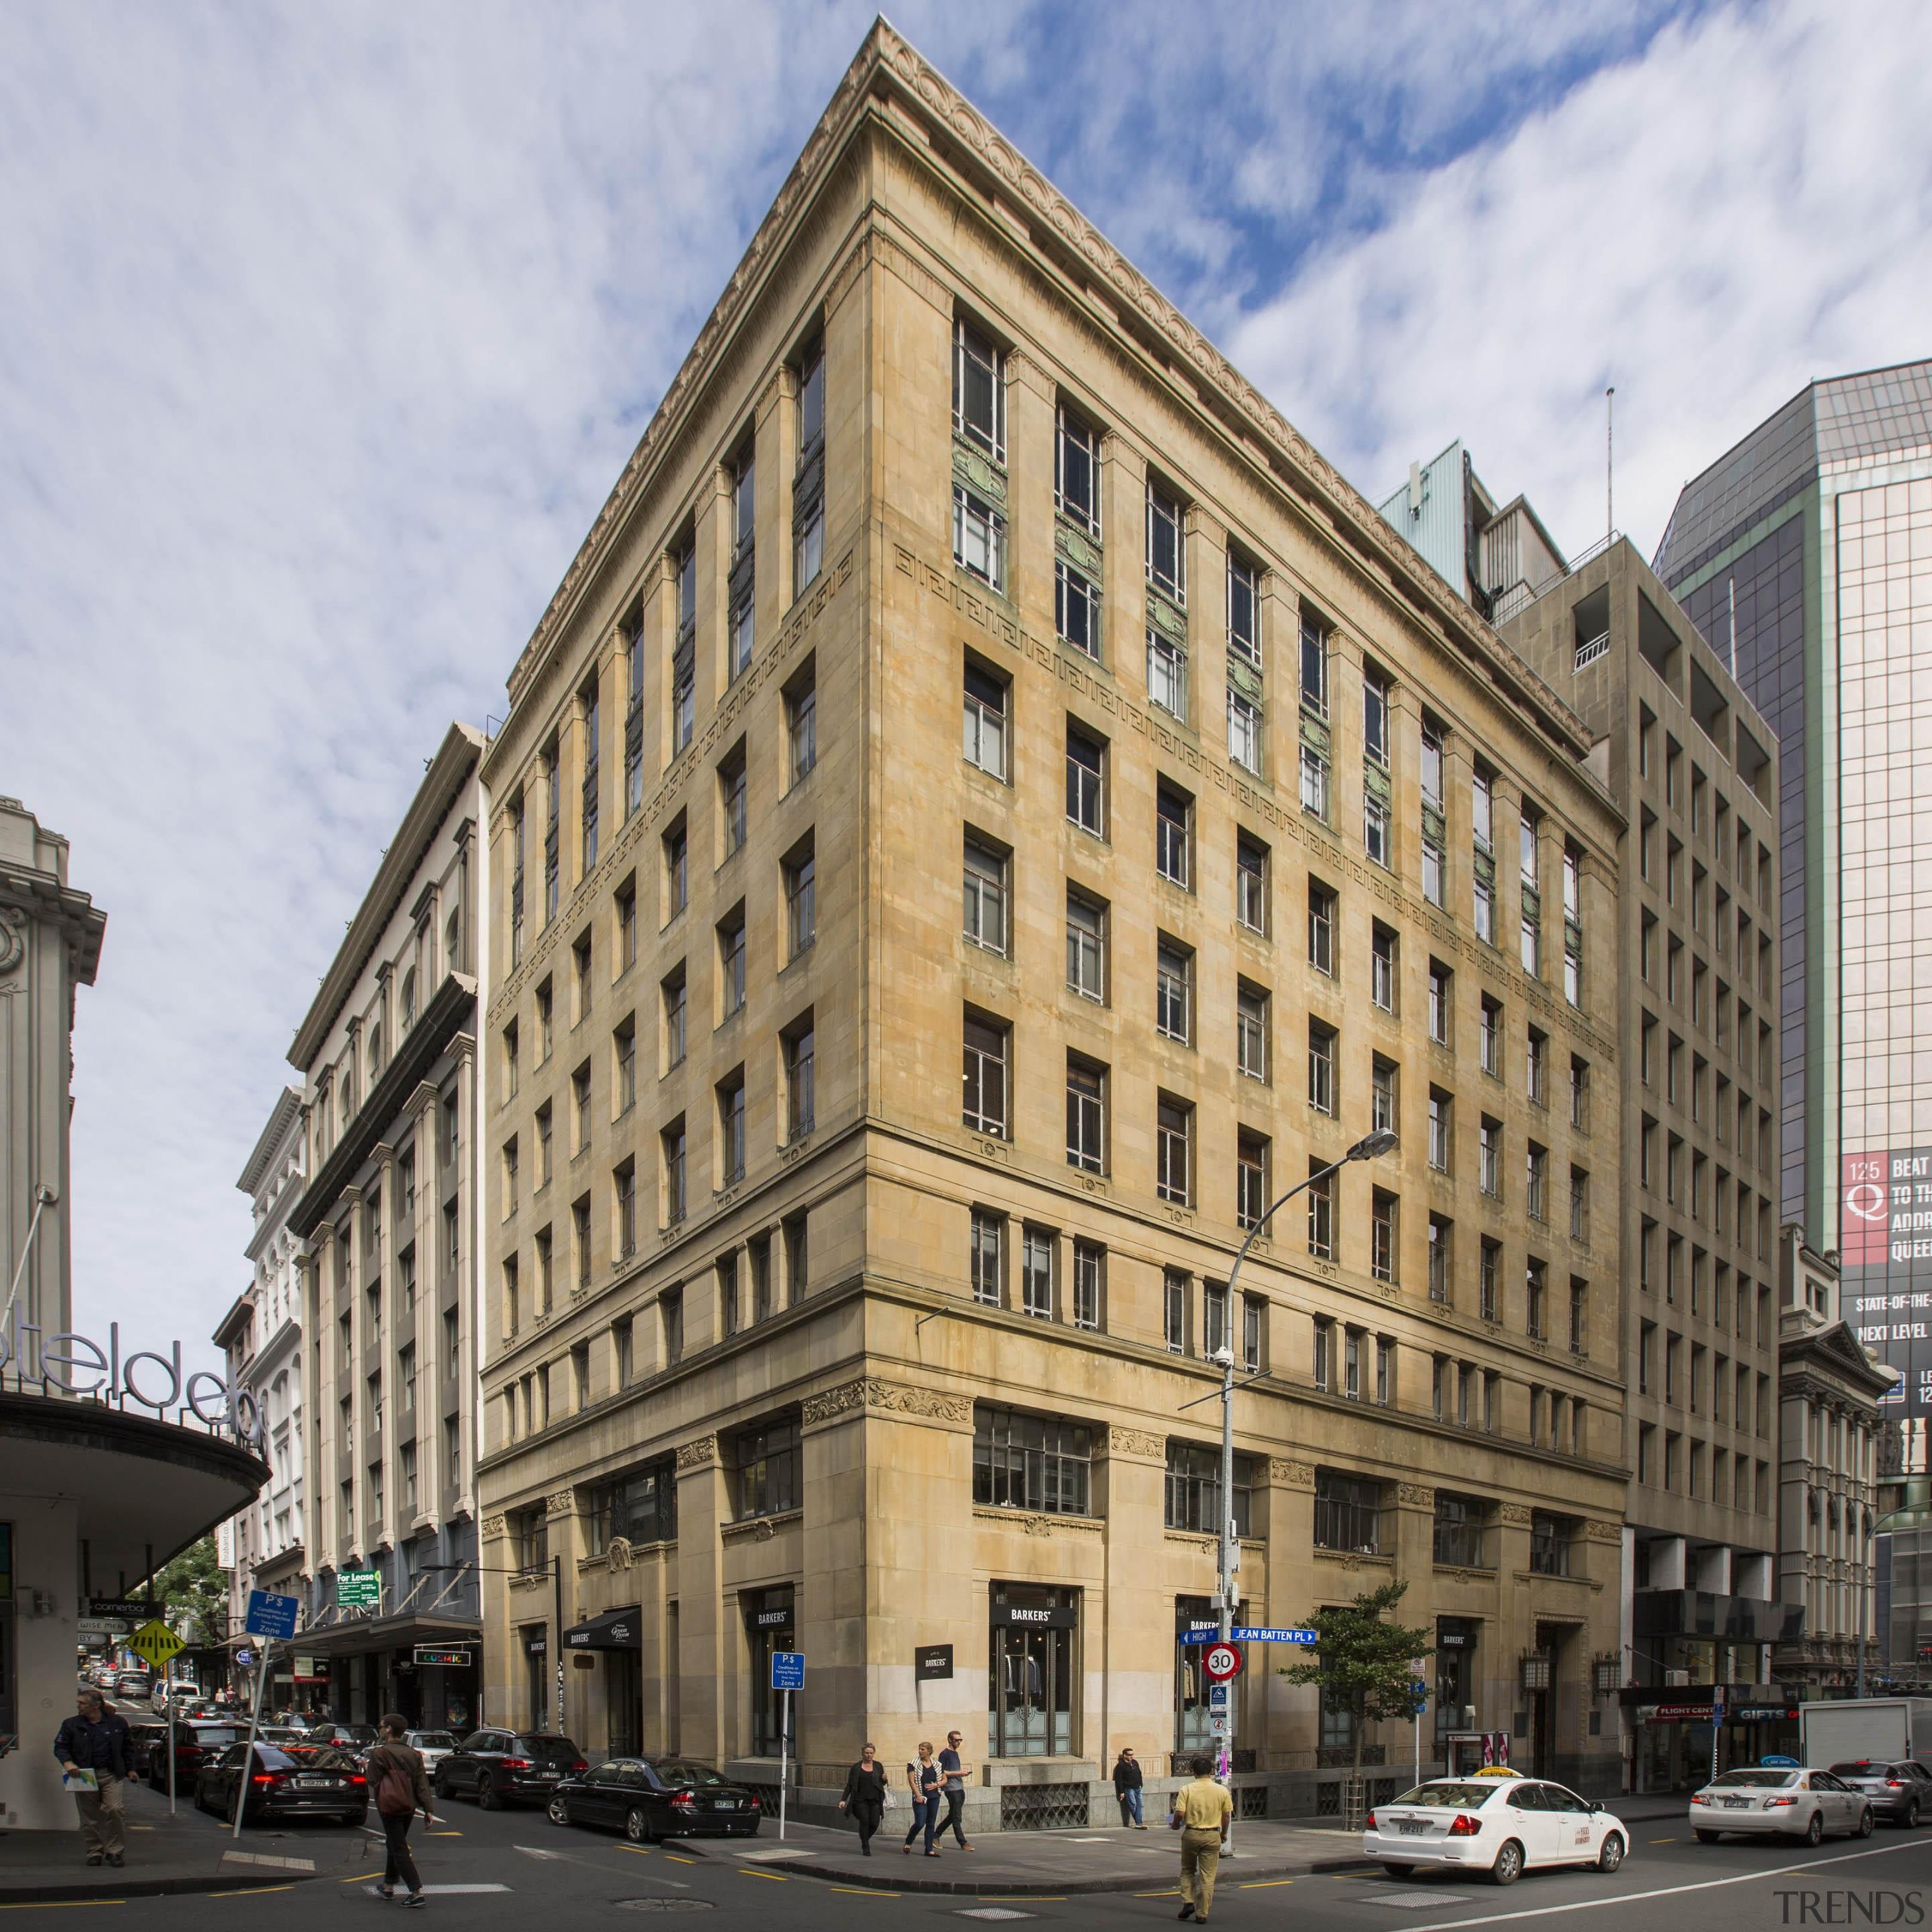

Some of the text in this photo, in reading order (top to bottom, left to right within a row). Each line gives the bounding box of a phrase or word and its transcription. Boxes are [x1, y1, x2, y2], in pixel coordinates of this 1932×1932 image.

[1850, 1161, 1880, 1180] 125
[1893, 1157, 1929, 1178] BEAT
[1846, 1183, 1888, 1220] Q
[1892, 1186, 1911, 1204] TO
[1892, 1238, 1932, 1262] QUEE
[1857, 1323, 1927, 1342] NEXT LEVEL
[337, 1573, 374, 1582] For Lease
[259, 1625, 281, 1635] Zone
[1192, 1632, 1207, 1641] HIGH
[1236, 1629, 1305, 1641] JEAN BATTEN PL
[423, 1654, 463, 1663] COSMIC
[1211, 1654, 1231, 1669] 30
[1740, 1709, 1785, 1720] GIFTS
